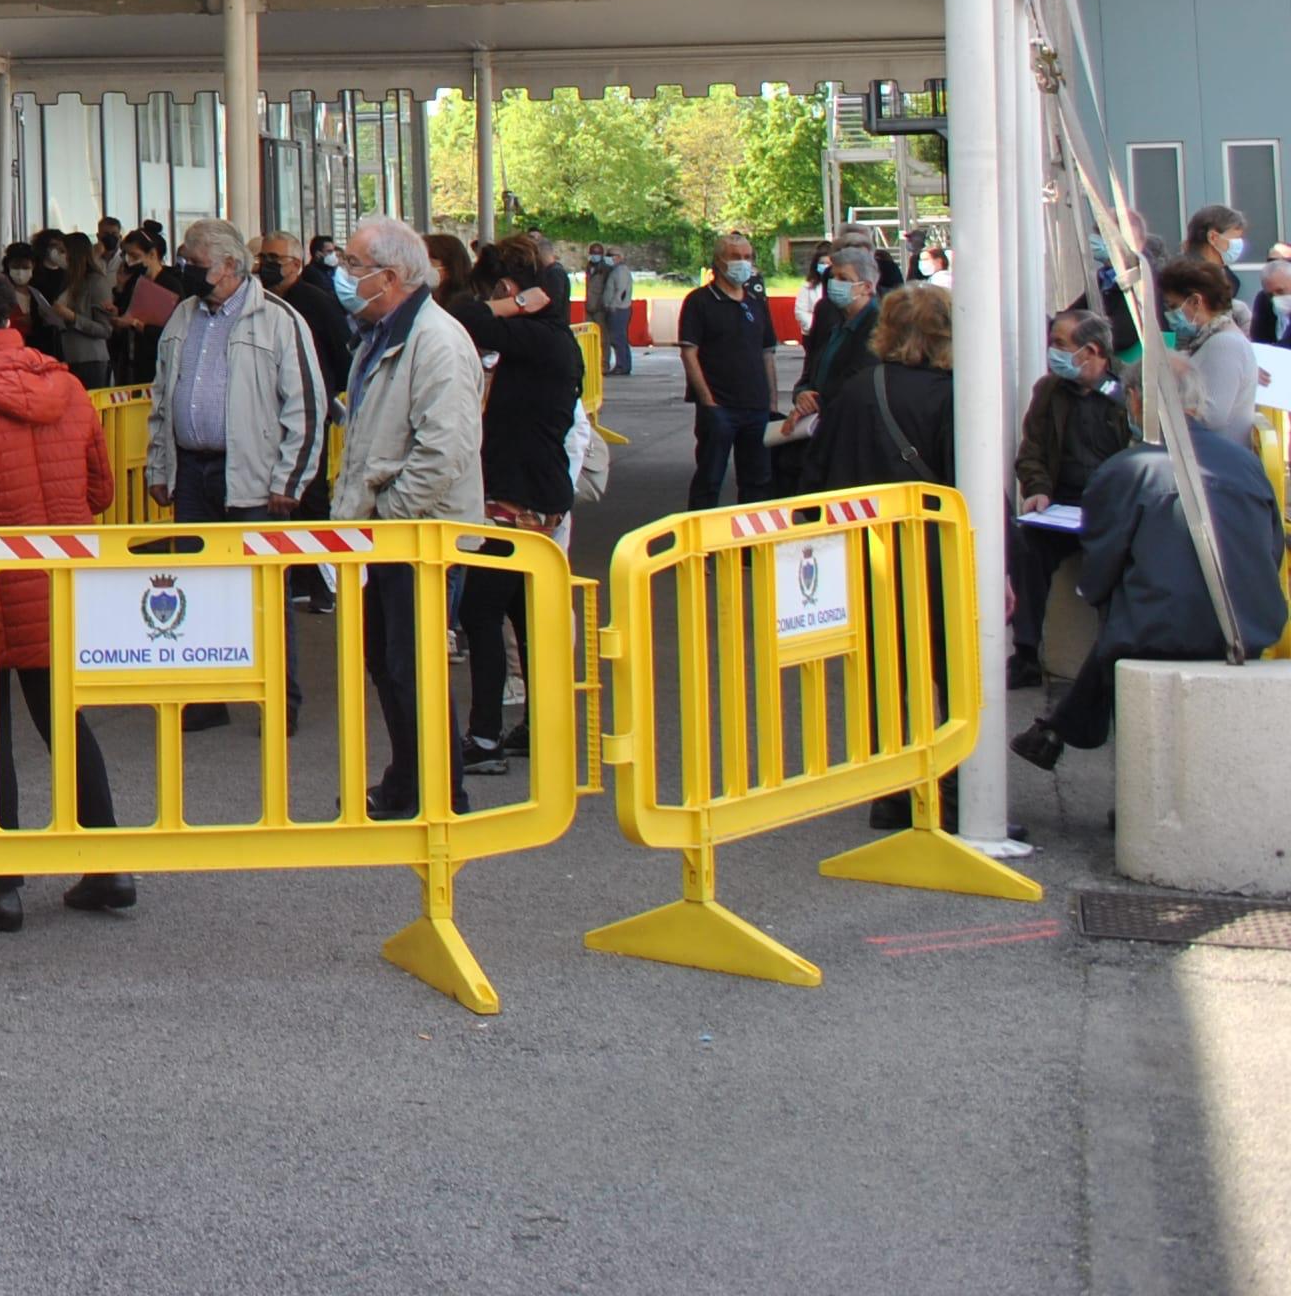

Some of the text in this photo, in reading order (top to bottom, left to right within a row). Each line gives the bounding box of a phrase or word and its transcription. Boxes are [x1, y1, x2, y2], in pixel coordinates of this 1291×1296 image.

[807, 613, 815, 625] DI
[818, 607, 847, 624] GORIZIA
[79, 647, 250, 664] COMUNE DI GORIZIA
